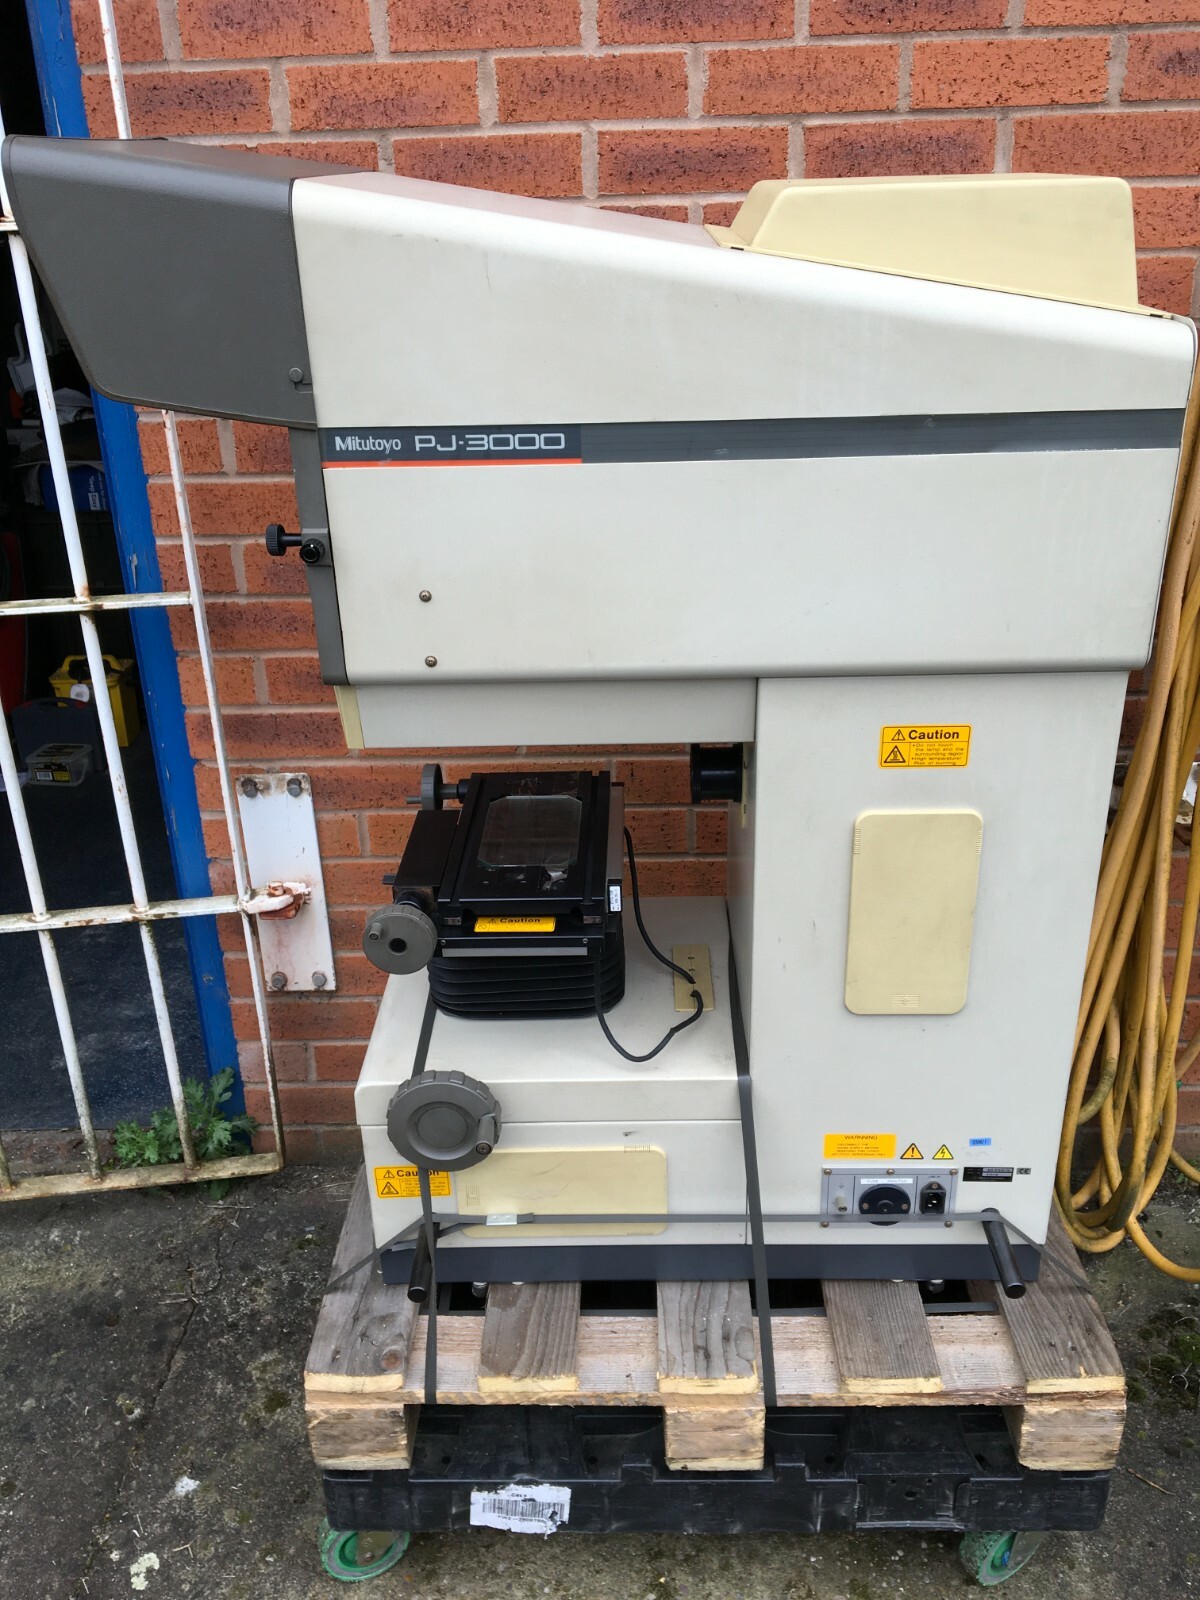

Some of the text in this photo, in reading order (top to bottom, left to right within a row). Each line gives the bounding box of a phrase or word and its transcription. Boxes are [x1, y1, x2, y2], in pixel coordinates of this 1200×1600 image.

[335, 433, 565, 454] Mitutoyo PJ-3000
[908, 730, 959, 740] Caution
